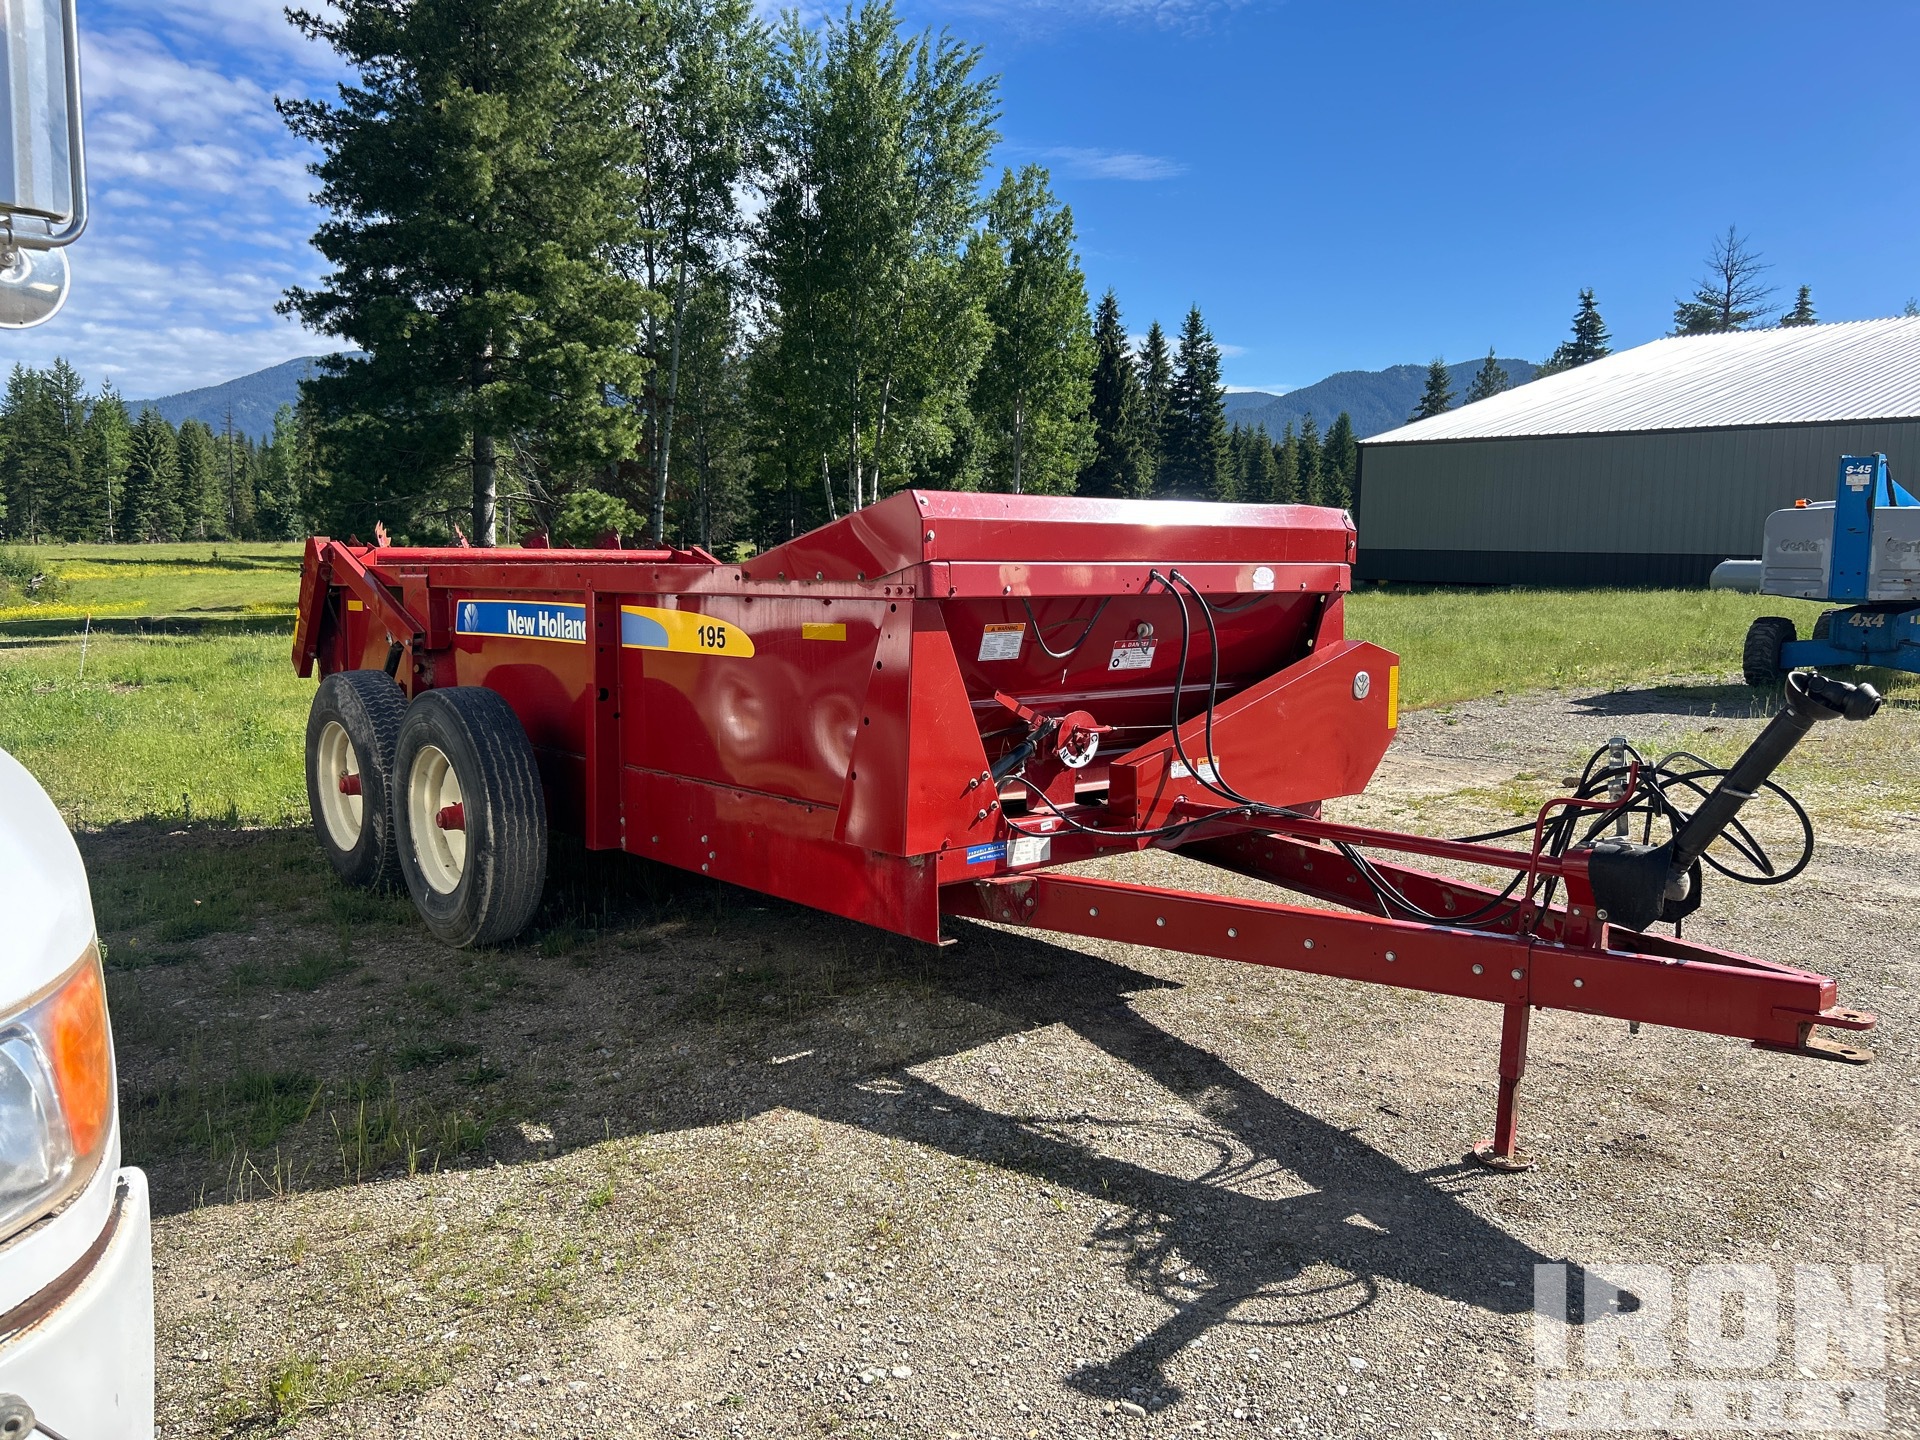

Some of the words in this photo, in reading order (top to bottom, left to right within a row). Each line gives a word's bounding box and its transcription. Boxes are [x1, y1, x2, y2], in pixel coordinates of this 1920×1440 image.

[1845, 465, 1873, 474] S-45
[507, 609, 536, 636] New
[1848, 612, 1885, 628] 4x4
[698, 625, 726, 649] 195
